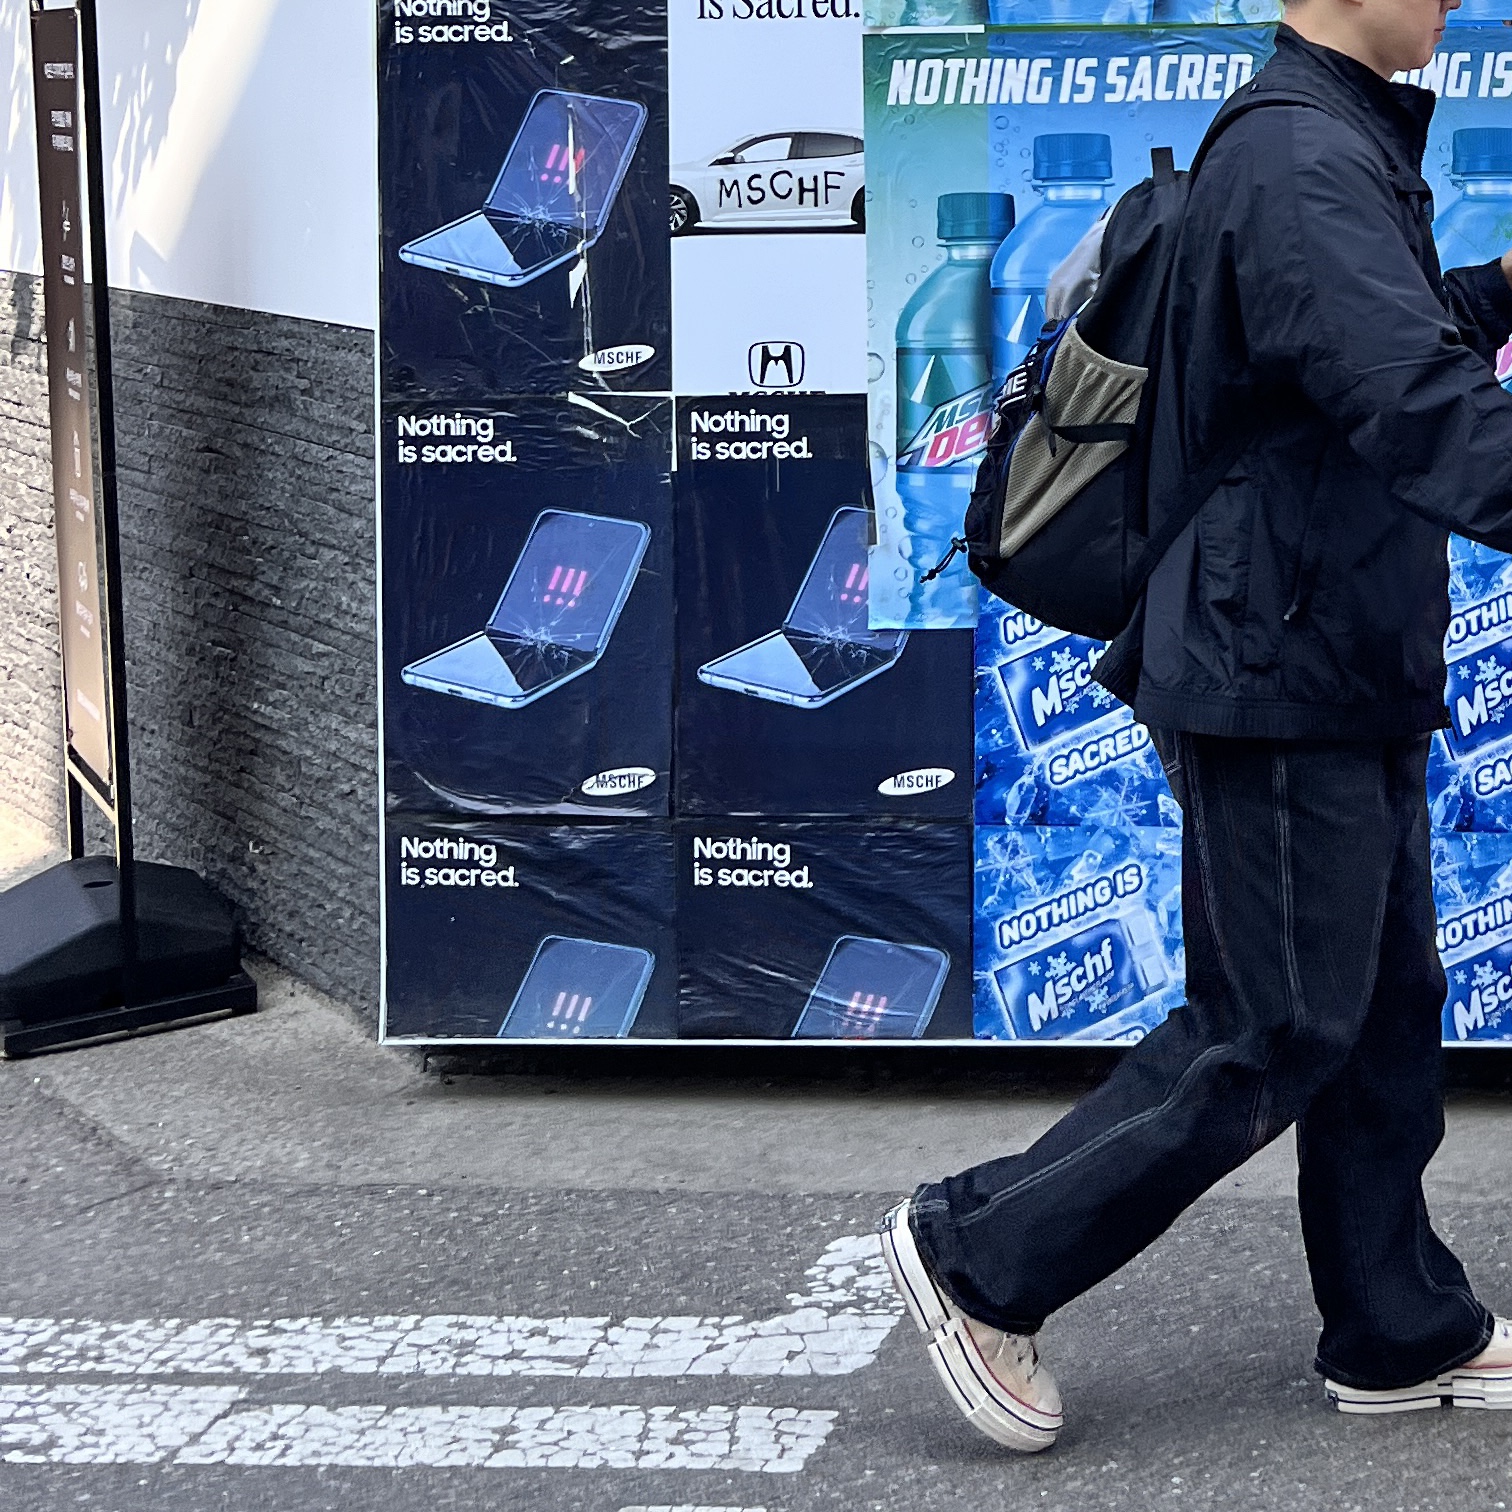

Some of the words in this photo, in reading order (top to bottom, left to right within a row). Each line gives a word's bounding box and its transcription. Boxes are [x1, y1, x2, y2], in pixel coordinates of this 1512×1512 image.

[395, 20, 414, 44] is
[418, 21, 513, 43] sacred.
[887, 57, 1055, 105] NOTHING
[1059, 56, 1099, 103] IS
[1104, 53, 1255, 103] SACRED
[718, 169, 845, 209] MSCHF
[593, 349, 643, 365] MSCHF
[397, 413, 494, 439] Nothing
[691, 409, 789, 437] Nothing
[398, 440, 417, 464] is
[421, 441, 517, 462] sacred.
[691, 438, 711, 460] is
[715, 437, 812, 461] sacred.
[1049, 722, 1149, 785] SACRED
[594, 772, 645, 789] MSCHF
[892, 772, 942, 789] MSCHF
[400, 836, 497, 866] Nothing
[693, 836, 790, 865] Nothing
[401, 863, 420, 885] is
[424, 863, 519, 887] sacred.
[693, 862, 713, 885] is
[717, 863, 813, 888] sacred.
[997, 880, 1111, 948] NOTHING
[1112, 864, 1143, 898] IS
[1026, 936, 1115, 1033] Mschf
